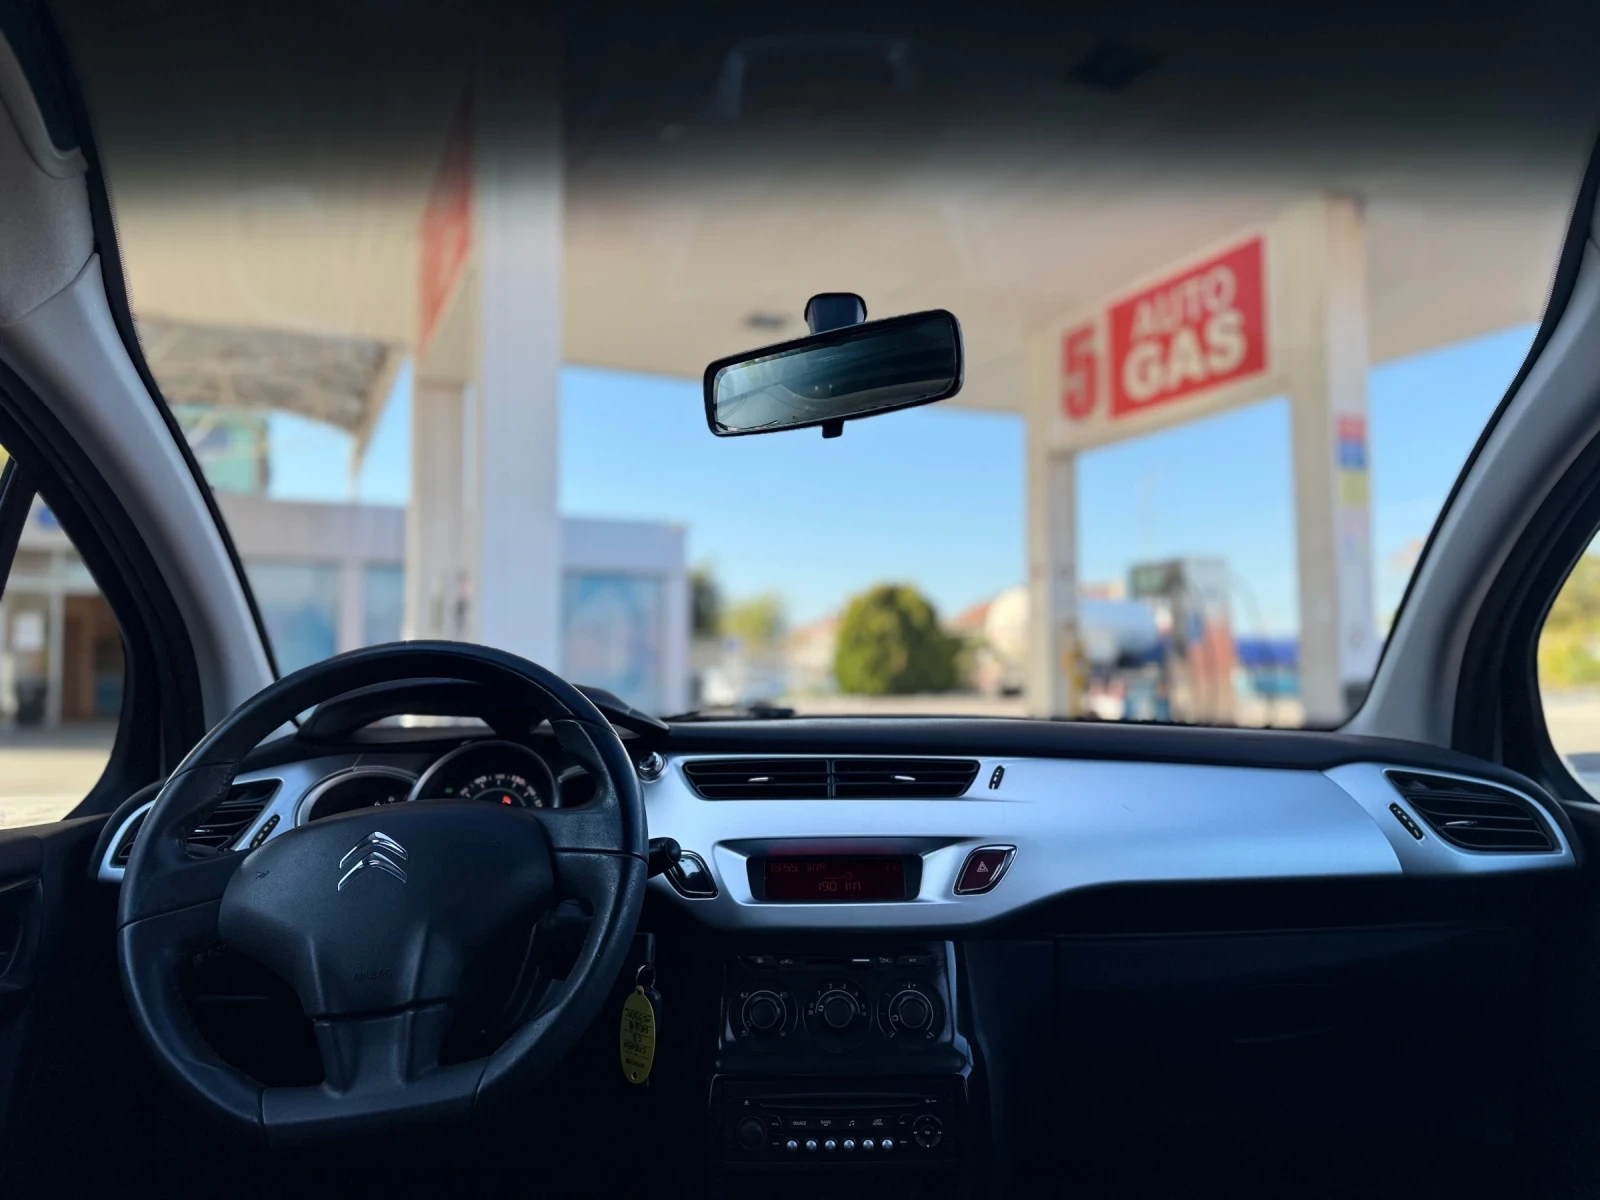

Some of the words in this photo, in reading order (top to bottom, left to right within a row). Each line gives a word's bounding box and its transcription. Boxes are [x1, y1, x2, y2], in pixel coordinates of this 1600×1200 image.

[1132, 264, 1237, 340] AUTO
[1062, 323, 1099, 421] 5
[1122, 309, 1247, 401] GAS
[817, 880, 838, 892] 190
[844, 880, 862, 892] KM
